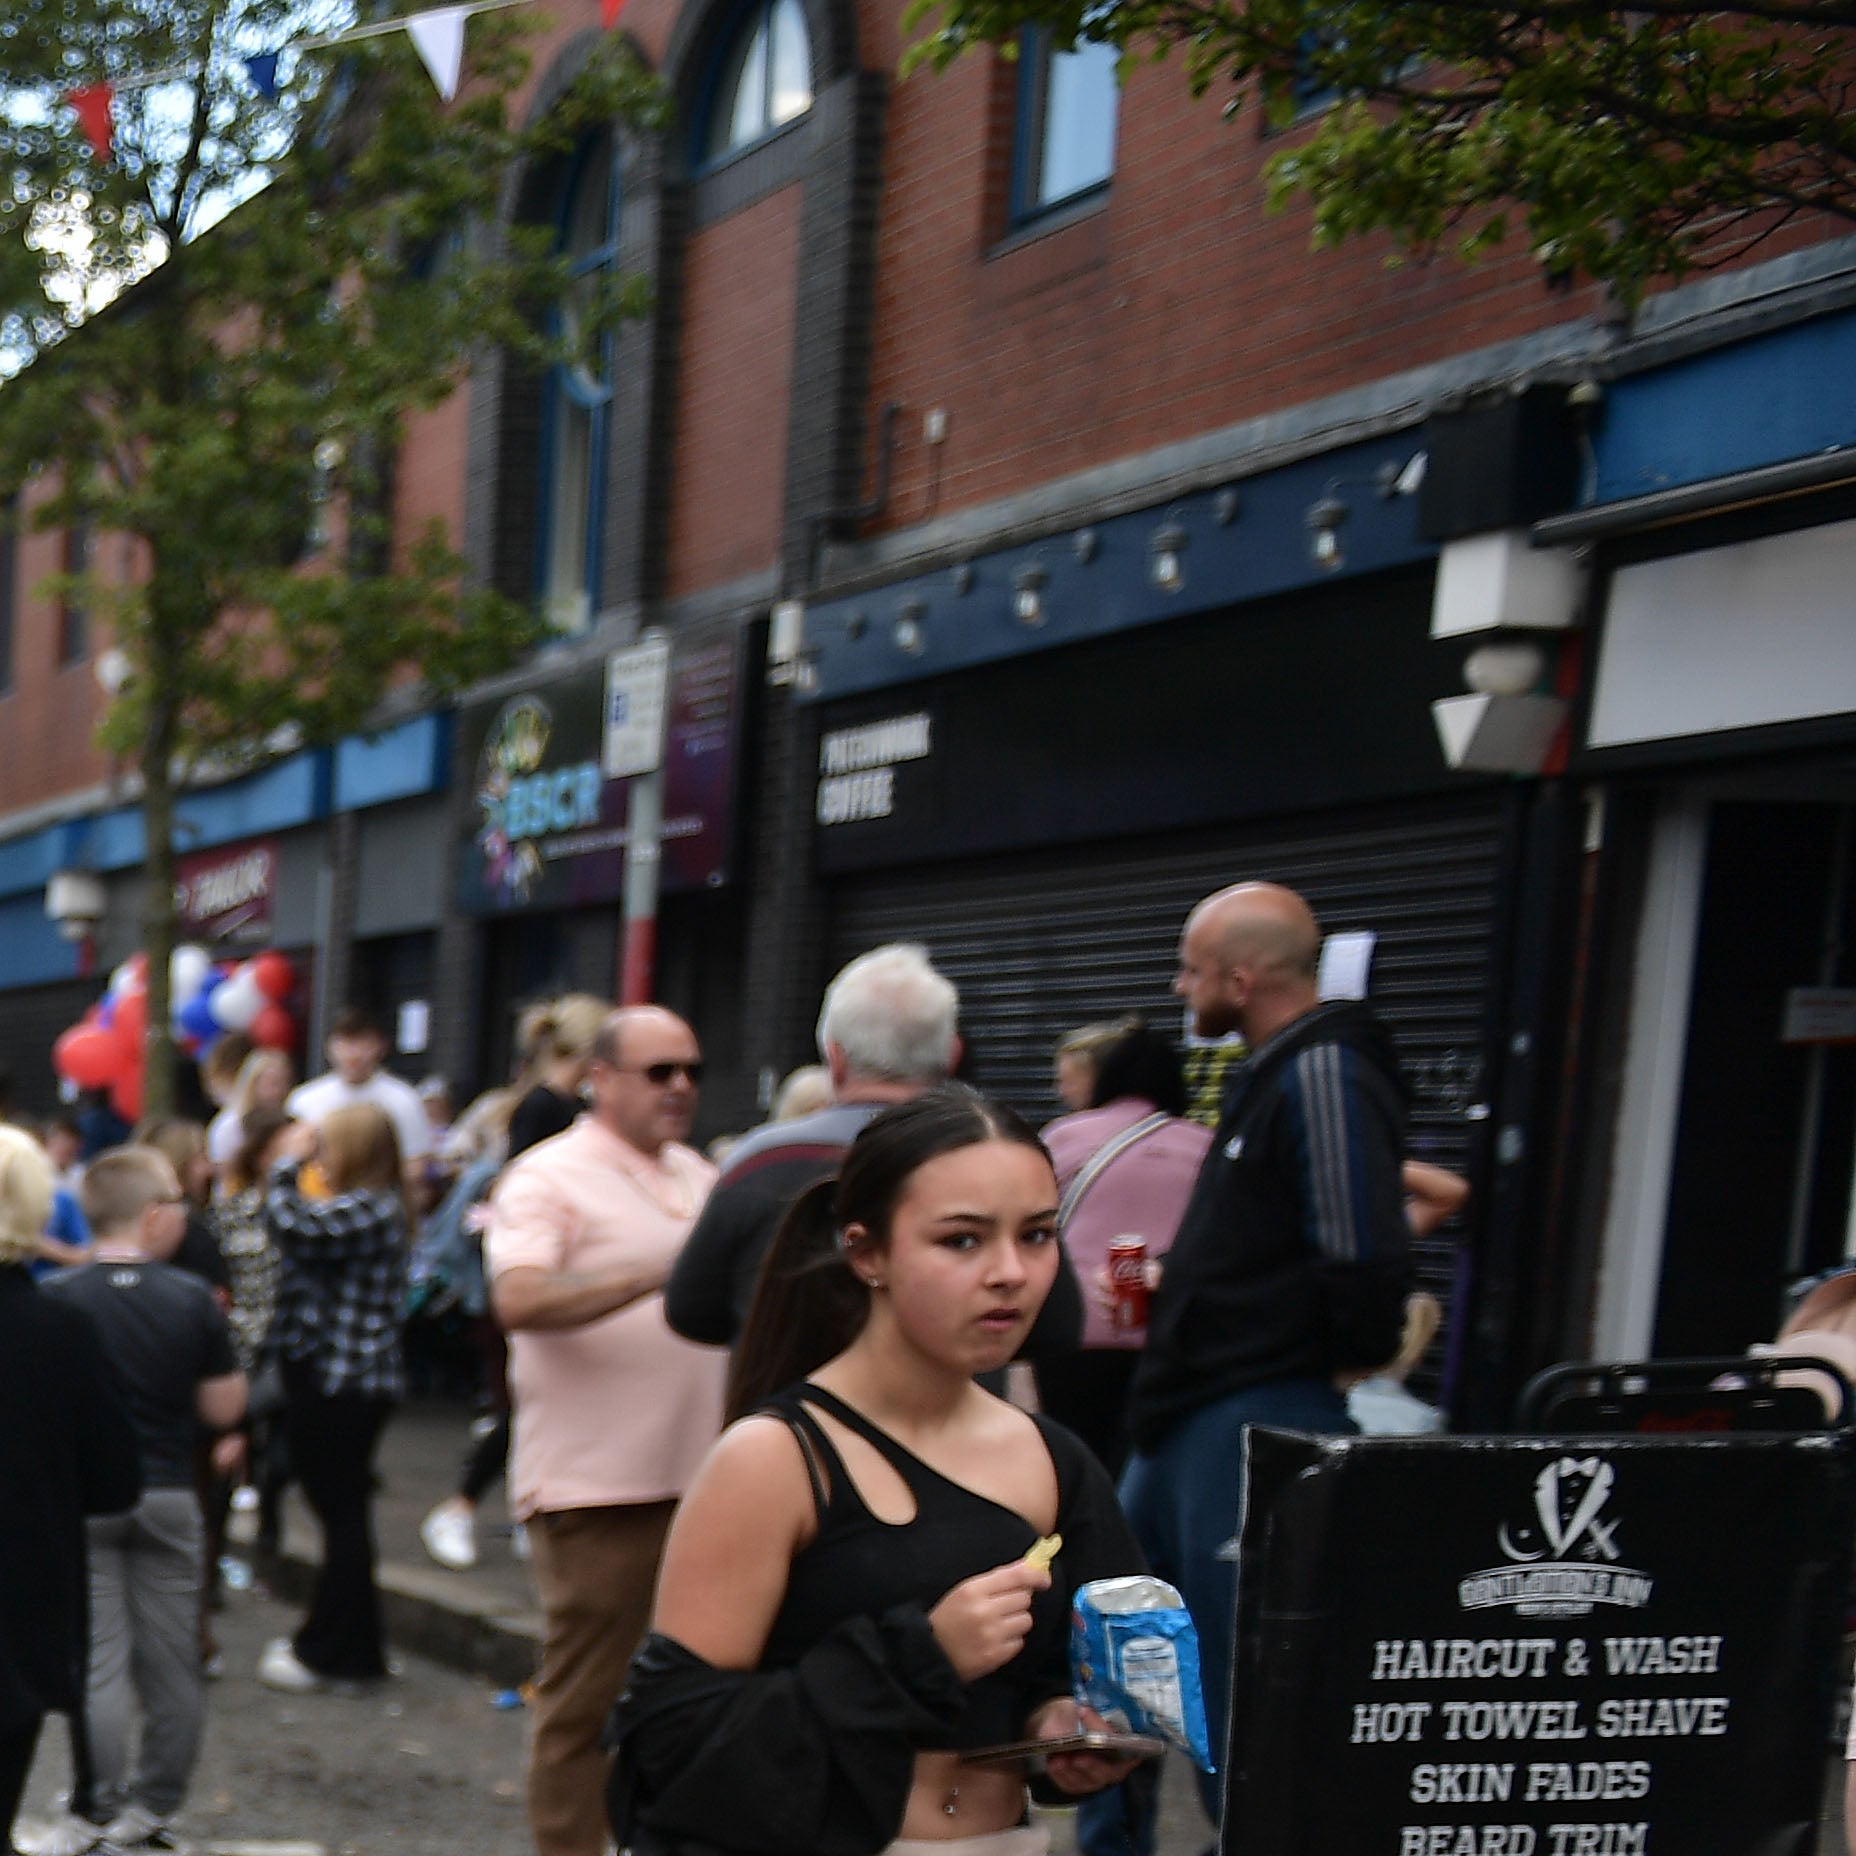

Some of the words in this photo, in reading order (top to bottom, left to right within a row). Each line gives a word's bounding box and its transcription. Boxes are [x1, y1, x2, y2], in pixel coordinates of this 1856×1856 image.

[1370, 1638, 1556, 1680] HAIRCUT
[1562, 1638, 1590, 1677] &
[1602, 1635, 1723, 1675] WASH
[1349, 1702, 1432, 1743] HOT
[1442, 1701, 1587, 1741] TOWEL
[1595, 1697, 1730, 1737] SHAVE
[1409, 1763, 1516, 1804] SKIN
[1524, 1760, 1651, 1800] FADES
